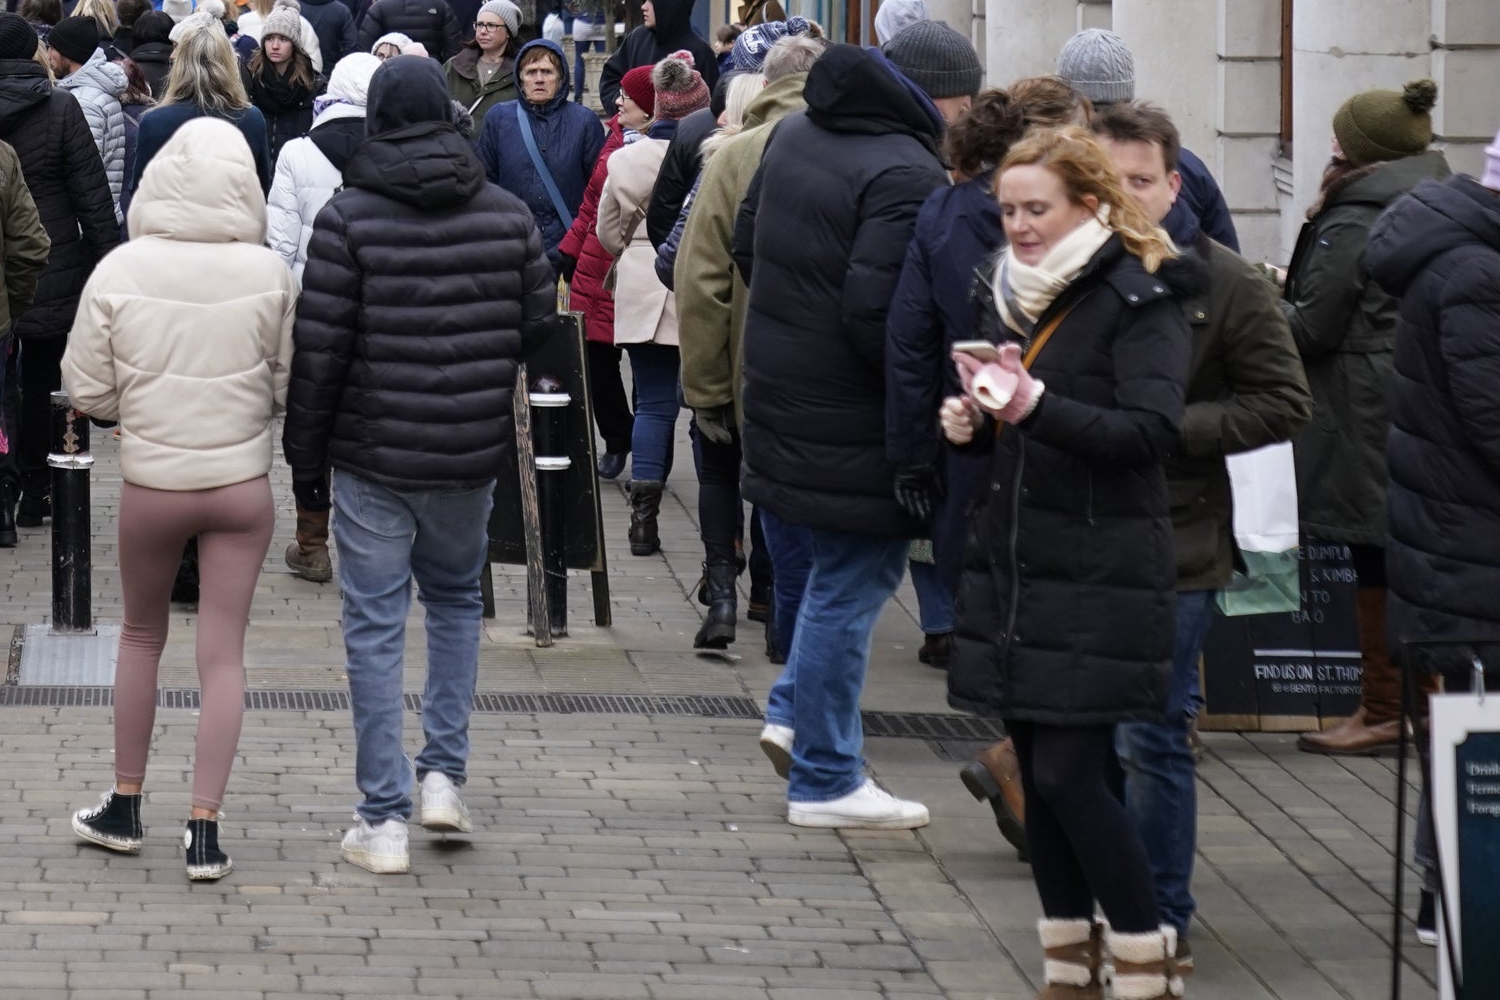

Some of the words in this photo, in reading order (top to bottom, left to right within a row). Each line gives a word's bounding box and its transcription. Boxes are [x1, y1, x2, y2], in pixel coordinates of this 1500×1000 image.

[1254, 665, 1280, 679] FIND
[1281, 665, 1296, 679] US
[1297, 665, 1313, 680] ON
